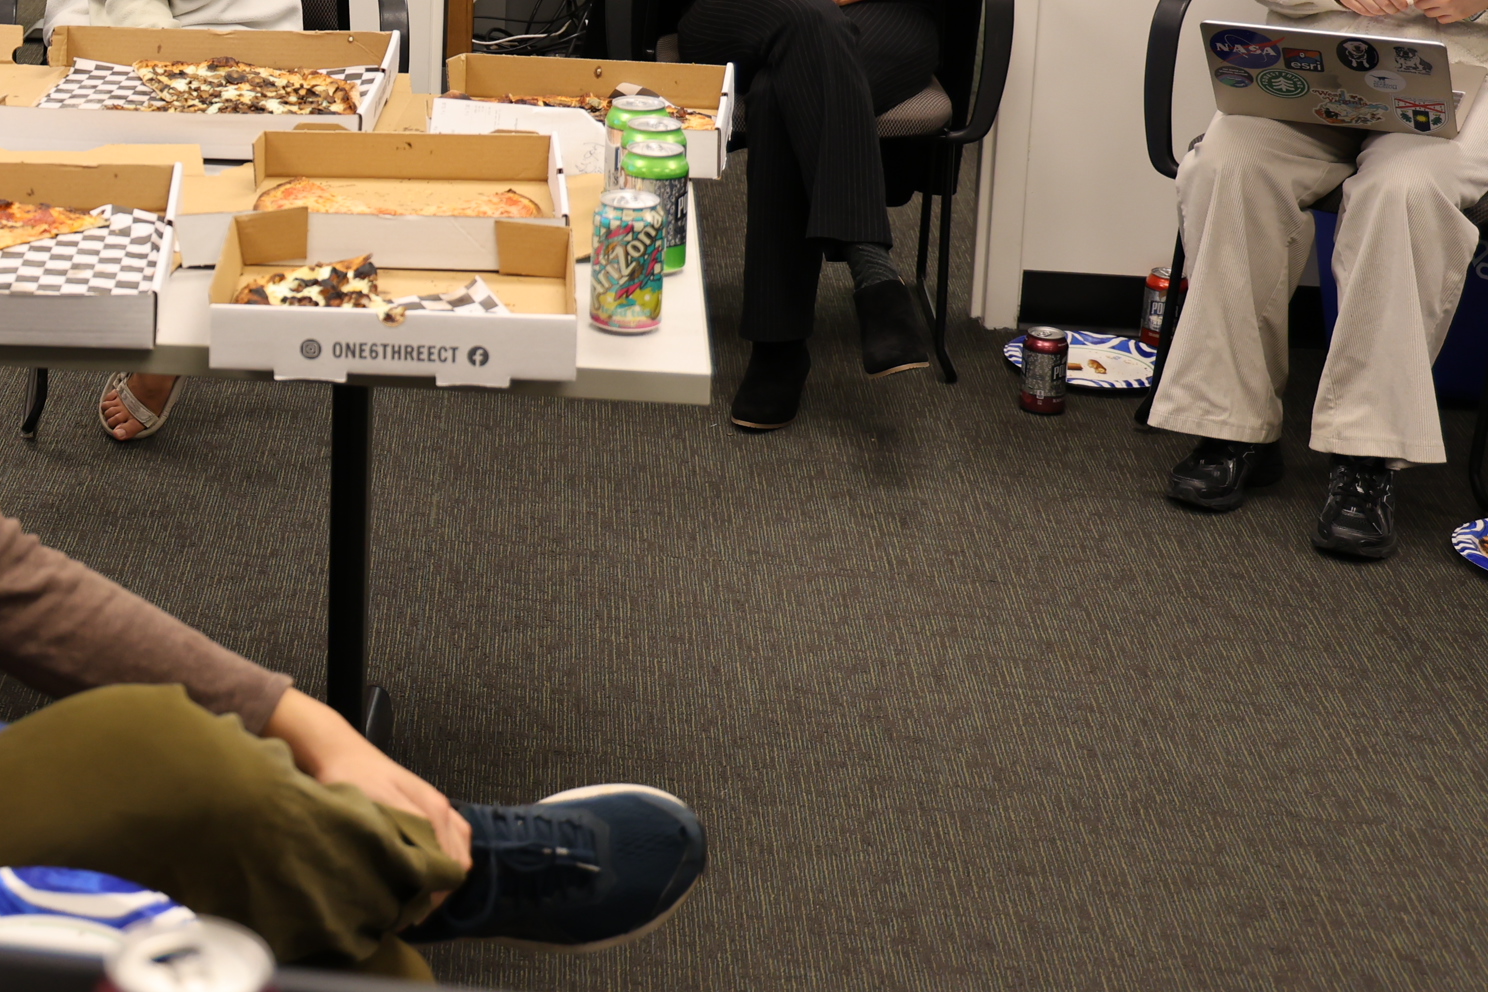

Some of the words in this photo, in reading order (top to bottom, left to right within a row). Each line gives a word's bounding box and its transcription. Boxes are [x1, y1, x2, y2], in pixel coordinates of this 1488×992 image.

[1215, 42, 1277, 56] NASA
[1290, 61, 1322, 71] esri
[332, 341, 460, 365] ONE6THREECT
